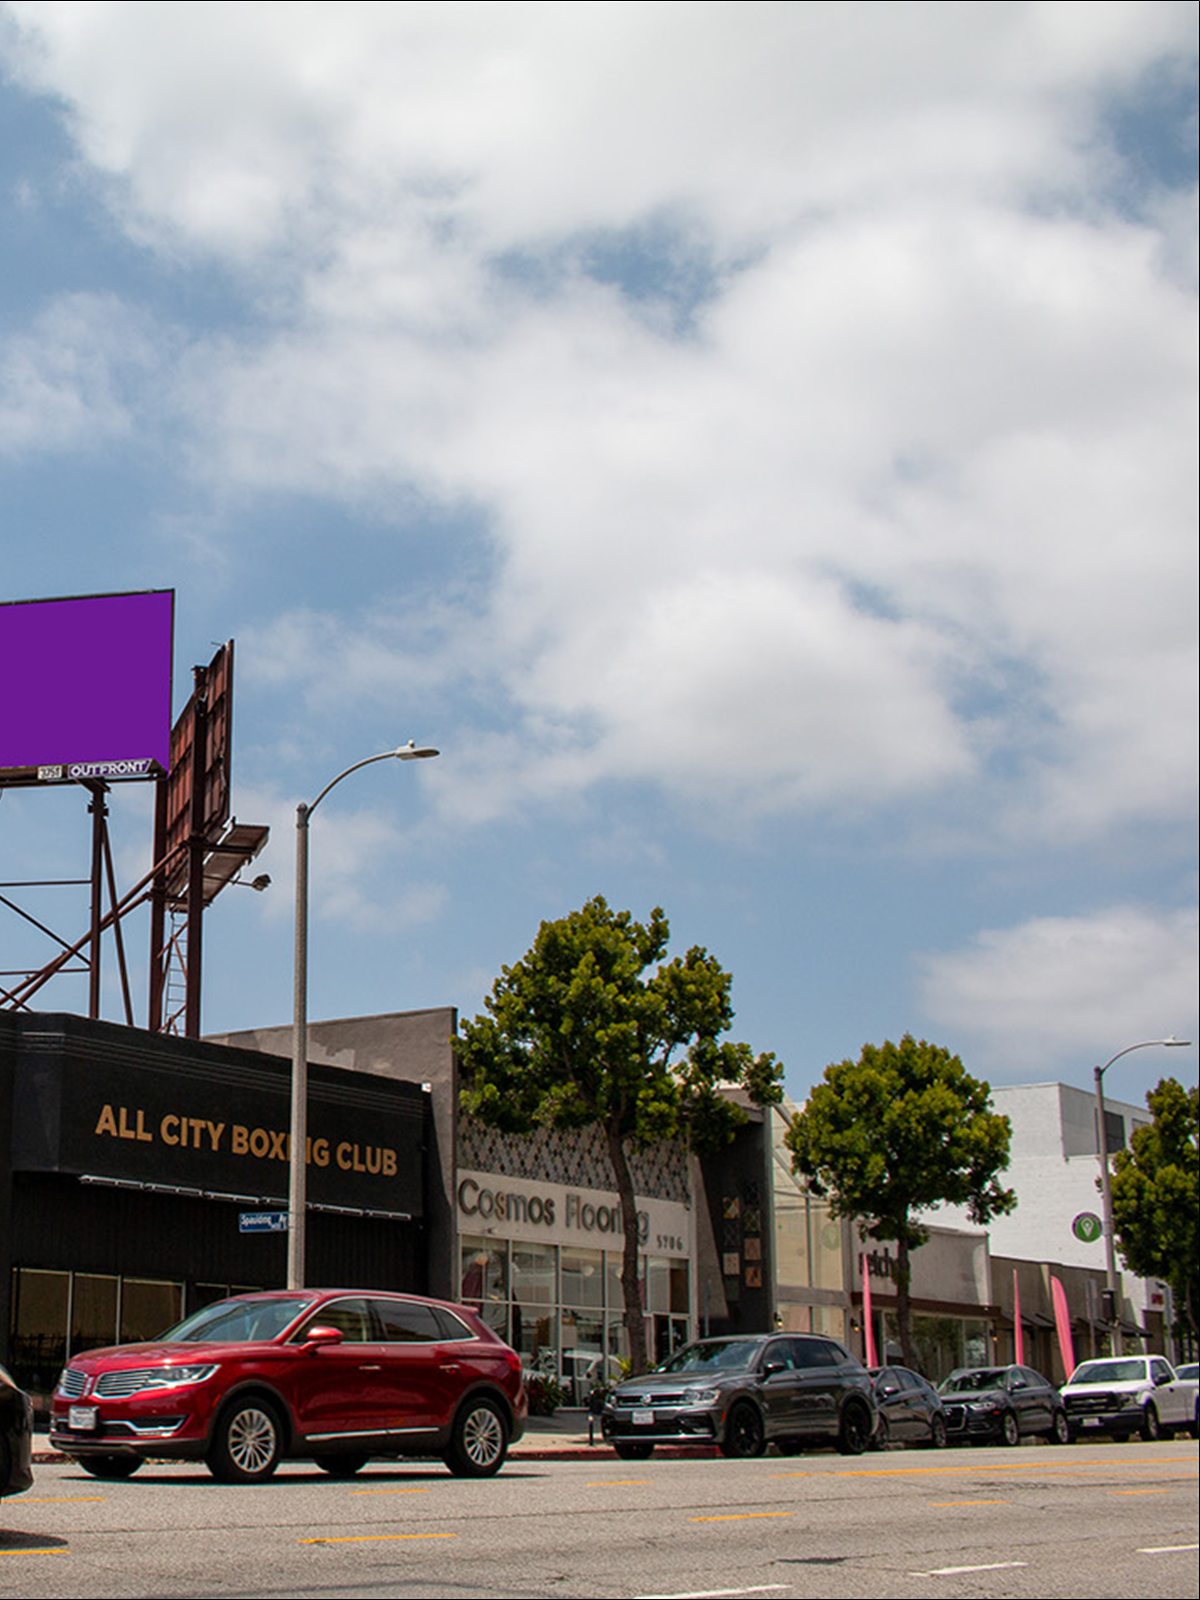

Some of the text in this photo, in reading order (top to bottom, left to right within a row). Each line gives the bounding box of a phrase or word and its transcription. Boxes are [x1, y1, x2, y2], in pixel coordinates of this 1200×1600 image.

[70, 761, 147, 776] OUTFRONT
[94, 1104, 153, 1142] ALL
[159, 1114, 225, 1151] CITY
[335, 1141, 399, 1177] CLUB
[457, 1178, 650, 1247] Cosmos Floorig
